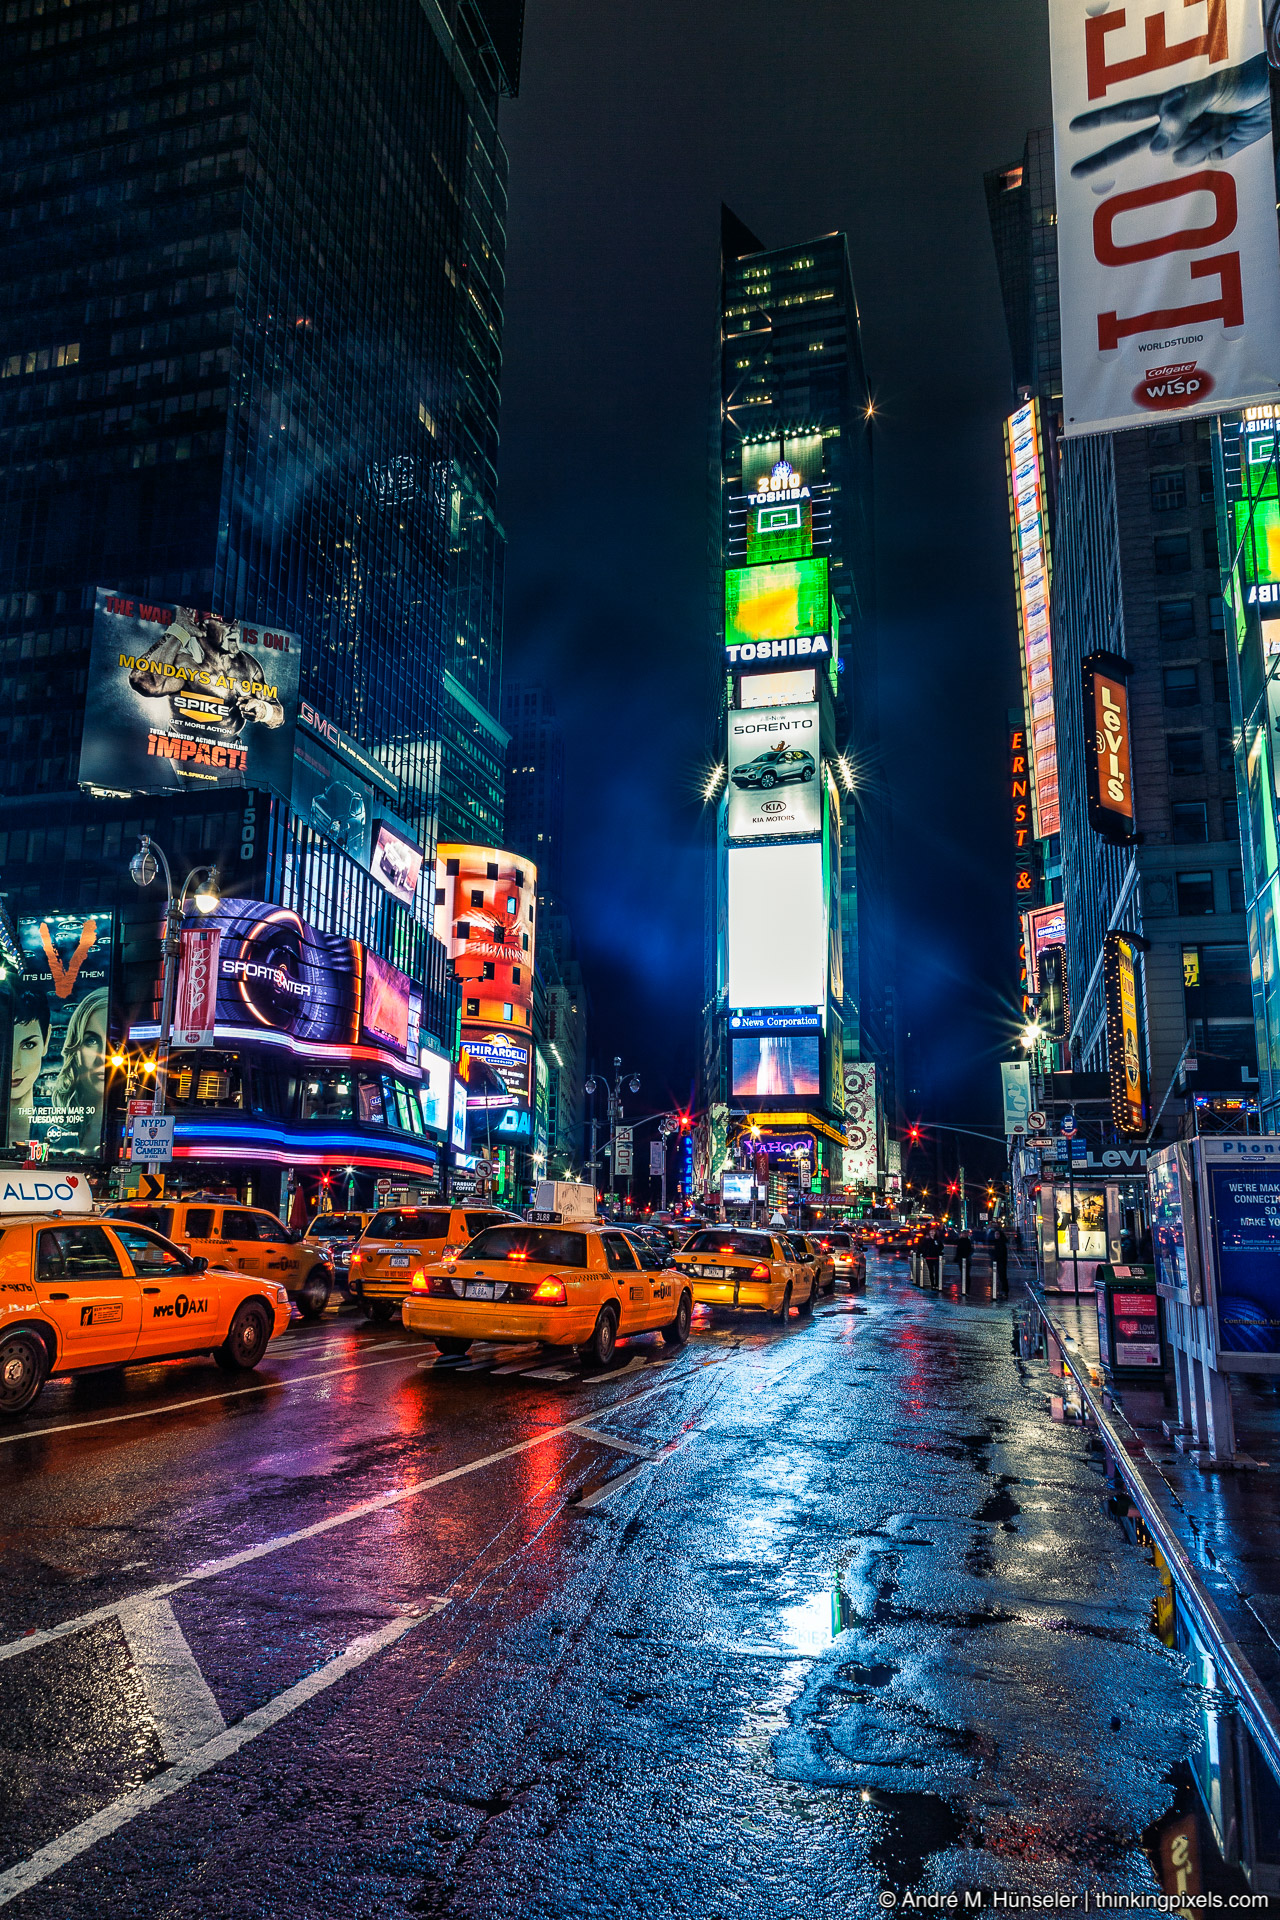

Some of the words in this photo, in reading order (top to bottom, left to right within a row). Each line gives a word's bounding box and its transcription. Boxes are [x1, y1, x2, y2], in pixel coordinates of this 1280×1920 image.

[1138, 334, 1204, 353] WORLDSTUDIO
[1148, 364, 1192, 378] Colgate
[1146, 376, 1200, 398] wisp
[758, 473, 800, 493] 2010
[748, 487, 811, 505] TOSHIBA
[105, 596, 135, 617] THE
[139, 603, 173, 626] WAR
[243, 627, 258, 645] IS
[263, 632, 290, 652] ON!
[726, 635, 828, 662] TOSHIBA
[118, 654, 211, 686] MONDAYS
[215, 675, 236, 690] AT
[241, 679, 278, 699] 9PM
[173, 696, 230, 717] SPIKE
[184, 722, 206, 730] MORE
[206, 725, 232, 735] ACTION
[301, 702, 338, 745] GMC
[734, 719, 813, 735] SORENTO
[149, 728, 167, 736] TOTAL
[168, 731, 194, 742] NONSTOP
[195, 736, 216, 746] ACTION
[217, 740, 249, 752] WRESTLING
[1012, 732, 1028, 847] ERNST
[240, 790, 256, 860] 1500
[752, 816, 764, 824] KIA
[765, 814, 795, 823] MOTORS
[1016, 871, 1032, 890] &
[39, 919, 97, 999] V
[23, 973, 38, 981] IT'S
[40, 973, 53, 981] US
[80, 970, 105, 979] THEM
[742, 1018, 764, 1027] News
[767, 1016, 818, 1028] Corporation
[18, 1107, 37, 1116] THEY
[39, 1106, 67, 1115] RETURN
[67, 1106, 84, 1115] MAR
[85, 1106, 96, 1115] 30
[28, 1115, 64, 1124] TUESDAYS
[141, 1119, 167, 1128] NYPD
[47, 1128, 61, 1138] abc
[135, 1138, 170, 1147] SECURITY
[743, 1139, 813, 1155] YAHOO!
[1223, 1142, 1280, 1153] Phon
[135, 1146, 167, 1155] CAMERA
[3, 1183, 74, 1201] ALDO
[1229, 1183, 1257, 1192] WE'RE
[1259, 1183, 1280, 1192] MAK
[536, 1212, 551, 1222] 3L88
[1264, 1206, 1277, 1215] SO
[1240, 1217, 1266, 1227] MAKE
[153, 1305, 174, 1318] NYC
[174, 1293, 209, 1319] TAXI
[1122, 1323, 1138, 1331] FREE
[1139, 1323, 1155, 1331] LOVE
[1223, 1318, 1267, 1326] Continental
